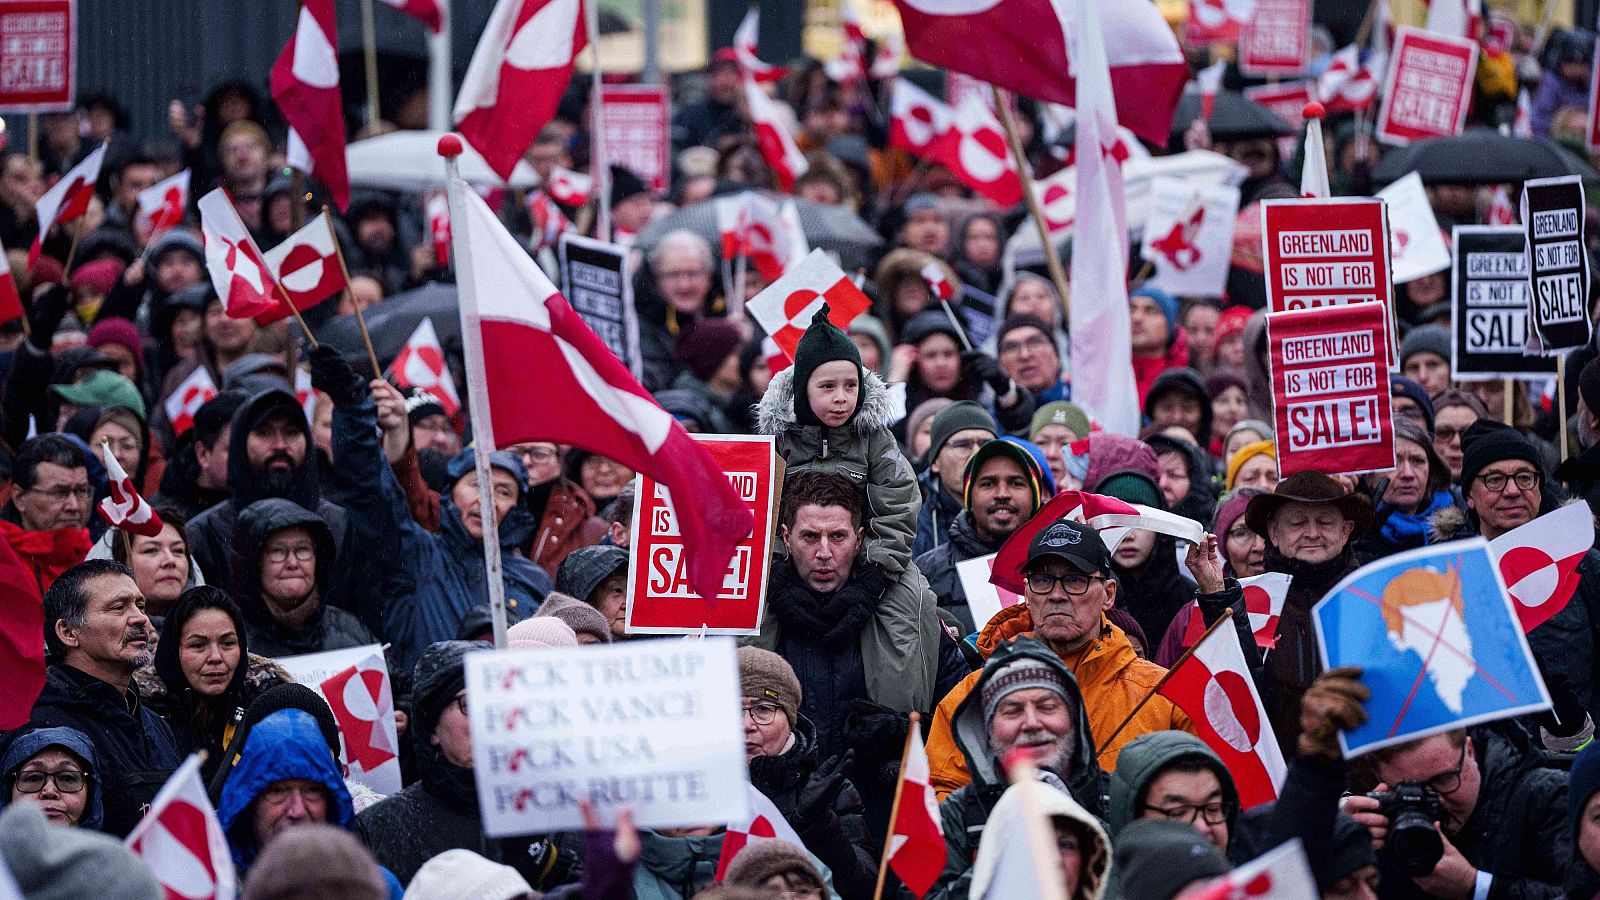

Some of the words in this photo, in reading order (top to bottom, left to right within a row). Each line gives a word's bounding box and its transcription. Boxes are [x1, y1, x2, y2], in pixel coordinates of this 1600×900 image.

[1535, 212, 1577, 235] GREENLAND
[1282, 233, 1369, 254] GREENLAND
[1537, 250, 1545, 267] IS
[1547, 247, 1562, 265] NOT
[1565, 245, 1579, 263] FOR
[1284, 267, 1298, 286] IS
[1306, 266, 1334, 285] NOT
[1343, 265, 1372, 285] FOR
[1470, 254, 1526, 272] GREENLA
[1470, 283, 1481, 300] IS
[1489, 282, 1513, 300] NOT
[1539, 277, 1582, 321] SALE!
[1470, 314, 1528, 347] SAL
[1285, 334, 1371, 361] GREENLAND
[1287, 373, 1301, 393] IS
[1308, 369, 1337, 391] NOT
[1345, 366, 1373, 388] FOR
[1290, 399, 1379, 447] SALE!
[655, 510, 670, 532] IS
[650, 547, 747, 595] SA!
[578, 654, 705, 686] TRUMP
[582, 690, 704, 723] VANCE
[585, 735, 655, 764] USA
[587, 771, 707, 805] RUTTE
